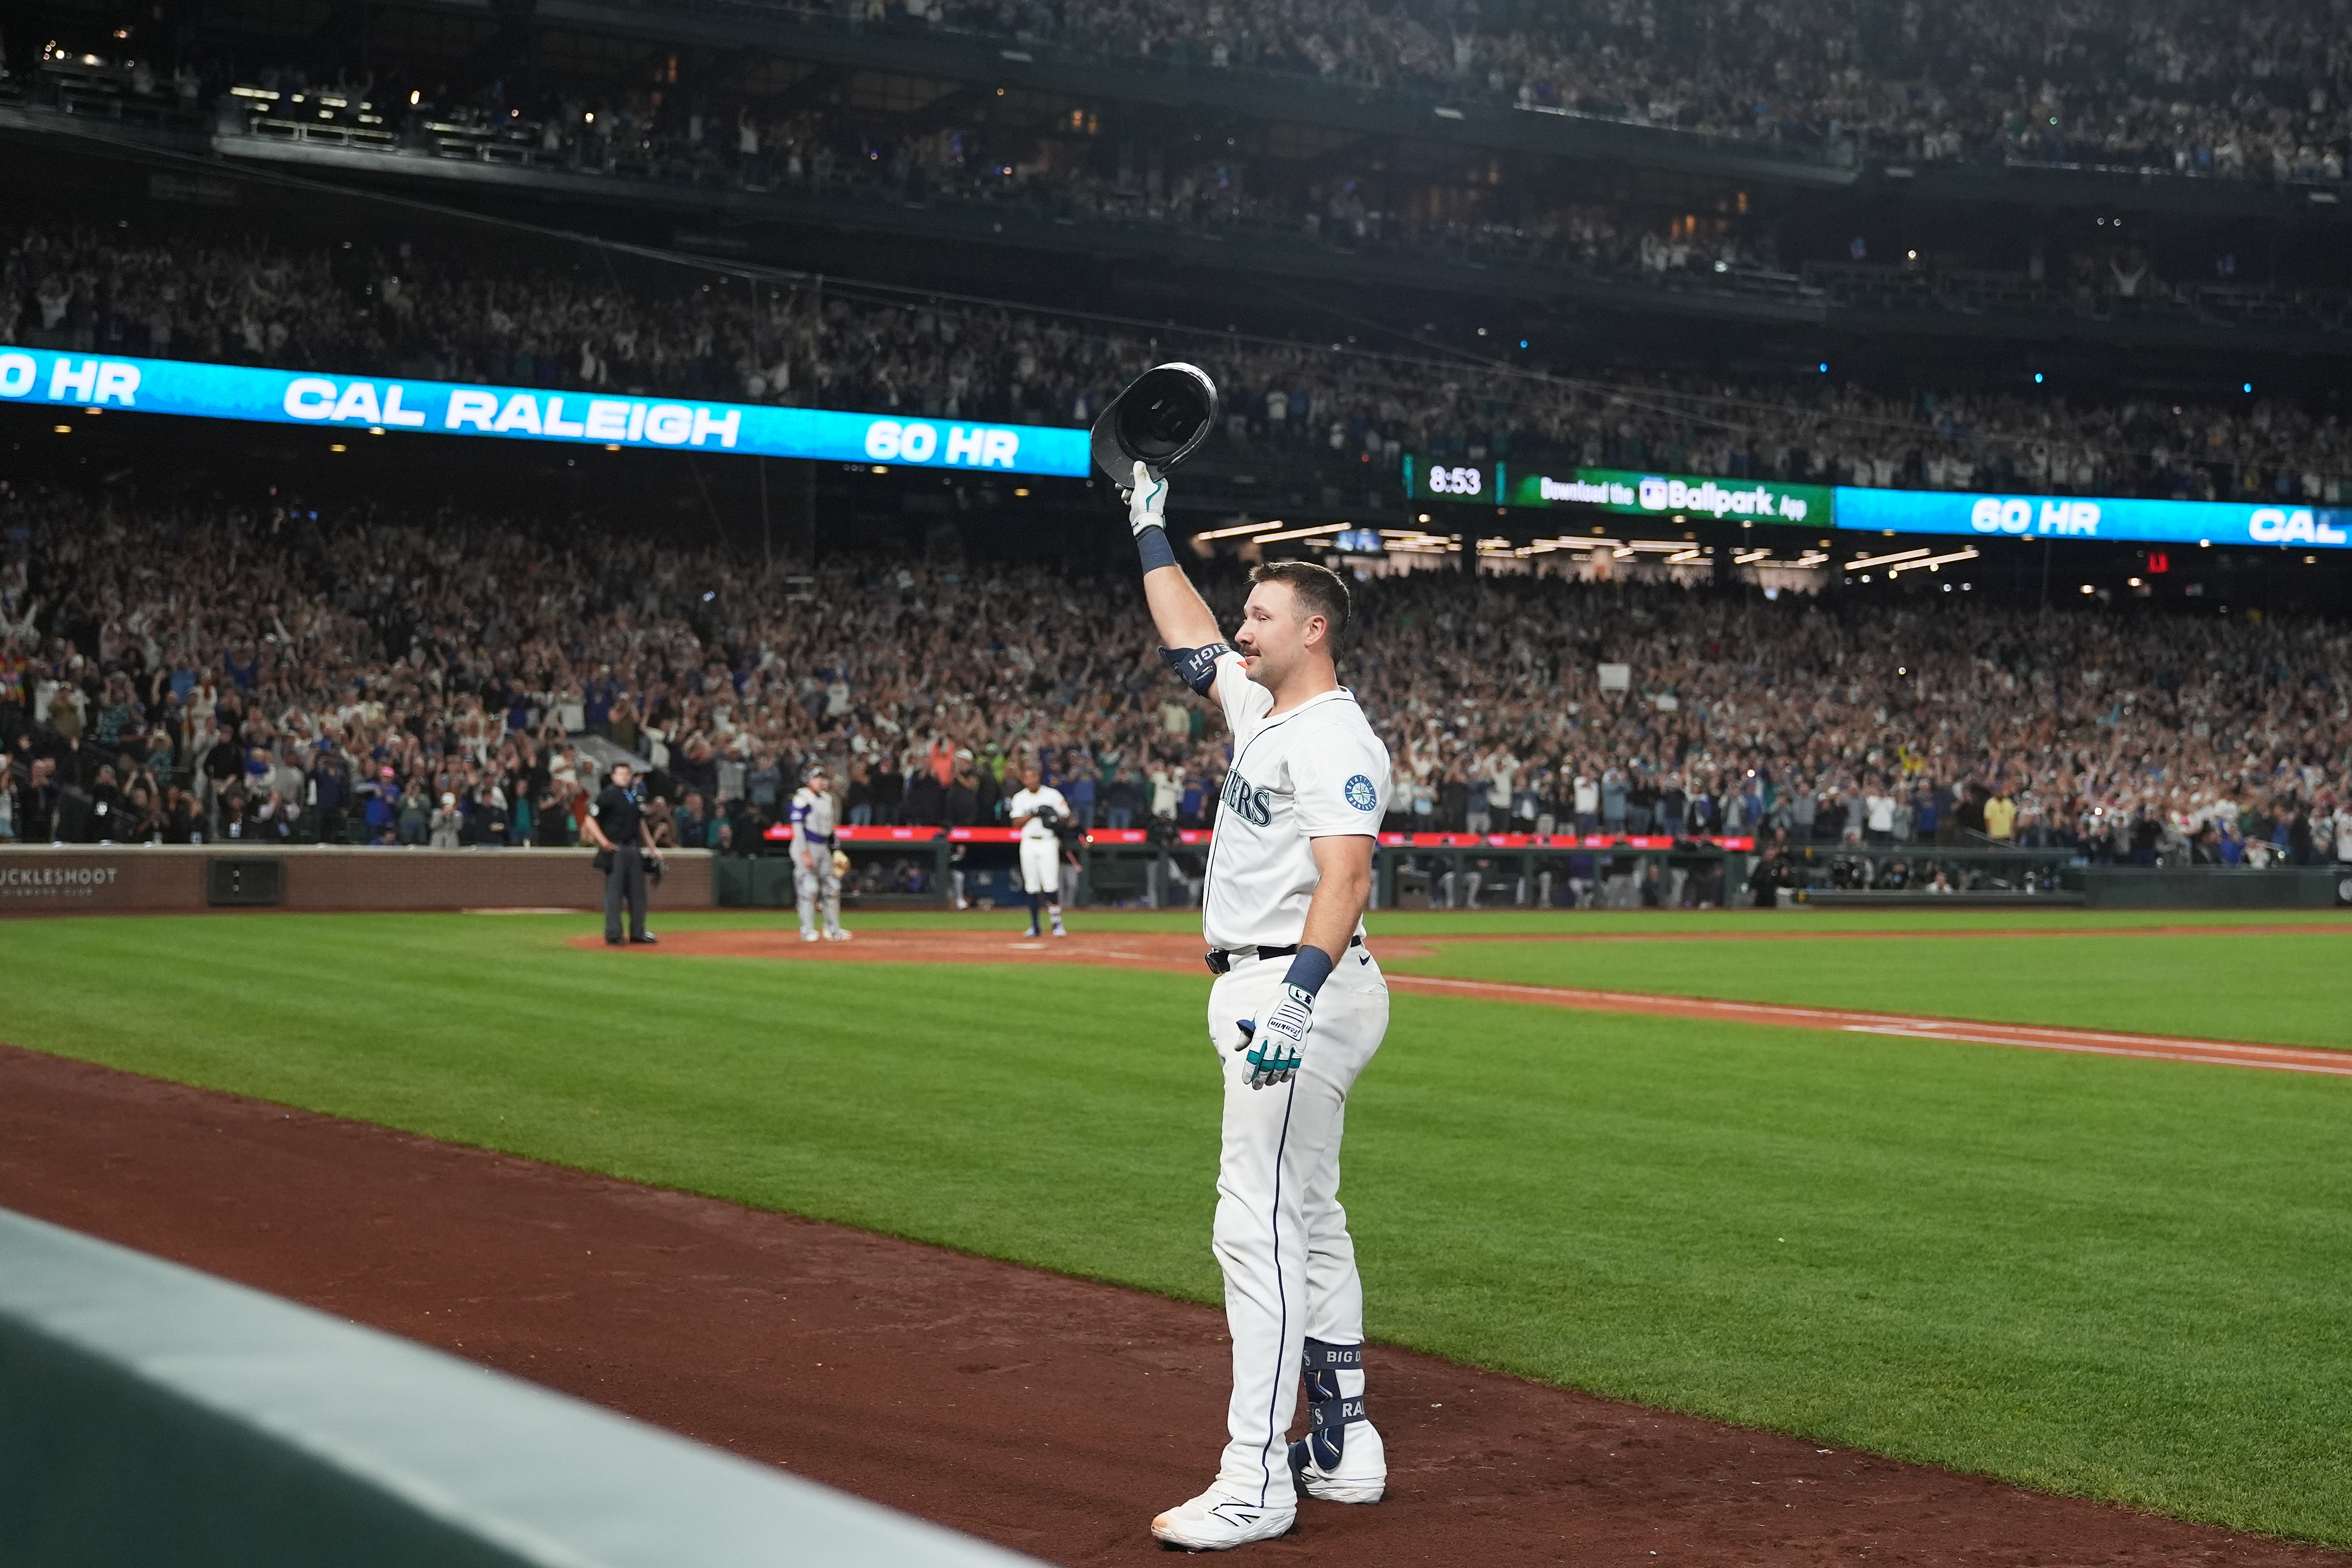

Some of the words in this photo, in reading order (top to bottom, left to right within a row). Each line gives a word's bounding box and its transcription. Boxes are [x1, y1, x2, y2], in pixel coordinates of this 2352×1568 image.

[47, 358, 141, 407] HR
[283, 377, 426, 427] CAL
[445, 389, 741, 448] RALEIGH
[865, 421, 937, 463] 60
[944, 427, 1019, 468] HR
[1429, 465, 1482, 495] 8:53
[1541, 476, 1609, 503] Download
[1610, 482, 1635, 505] the
[1668, 480, 1777, 518] Ballpark
[1779, 494, 1807, 521] App
[1970, 498, 2032, 534] 60
[2038, 502, 2101, 536] HR
[2249, 508, 2347, 544] CAL
[1271, 1021, 1301, 1037] Franklin
[1327, 1351, 1353, 1363] BIG
